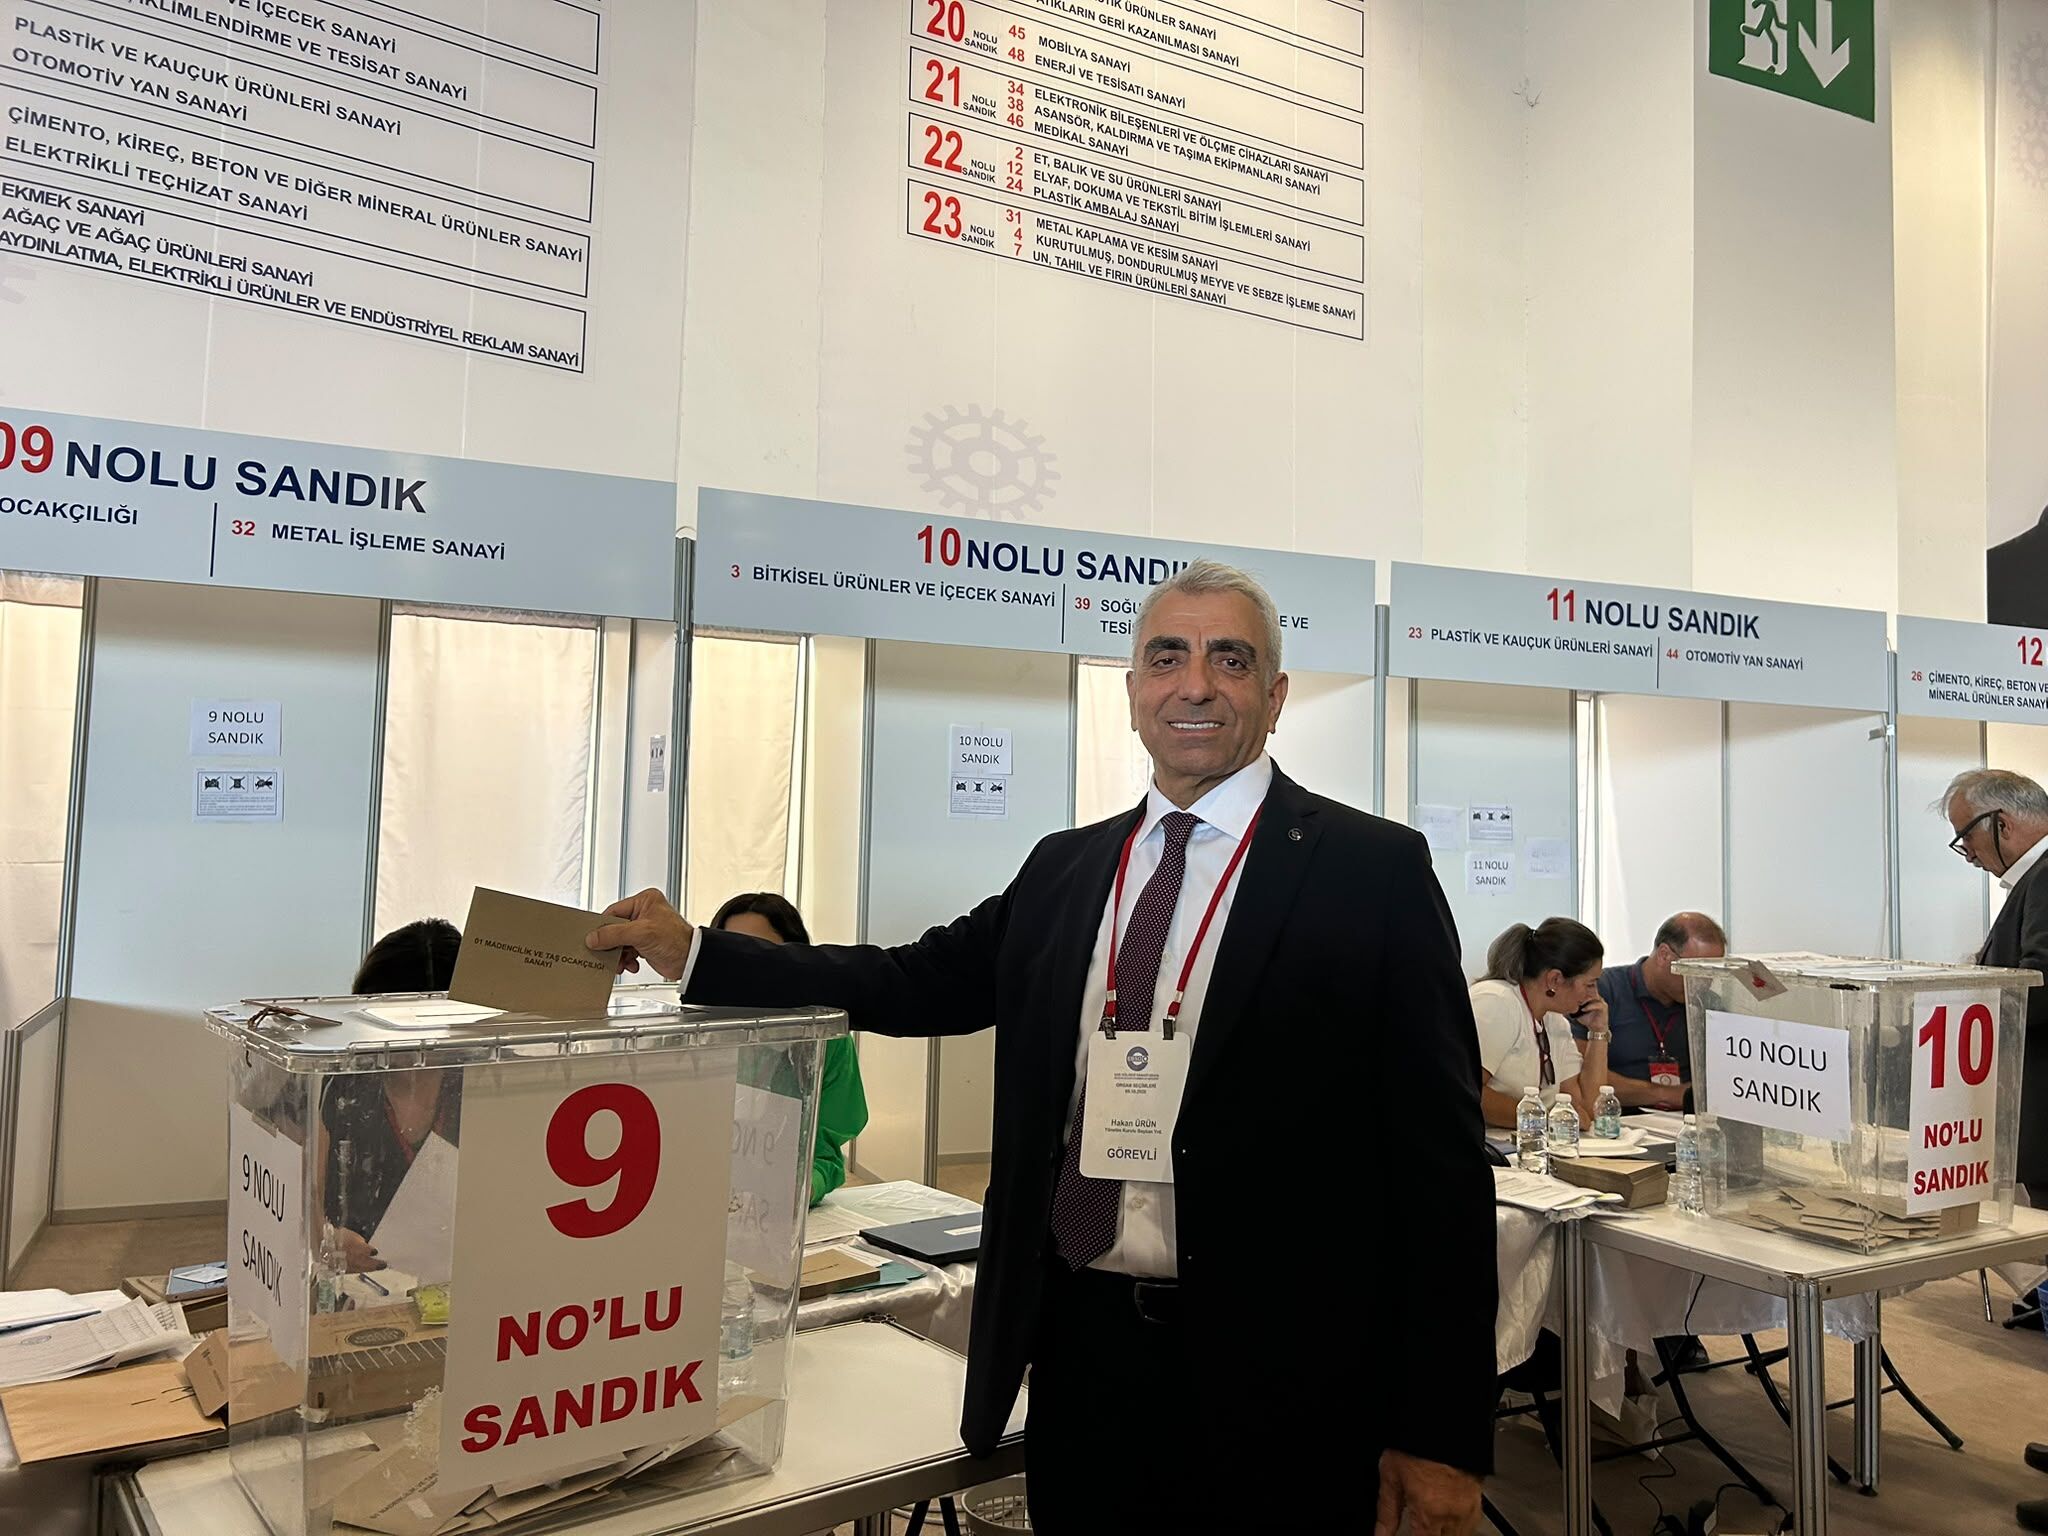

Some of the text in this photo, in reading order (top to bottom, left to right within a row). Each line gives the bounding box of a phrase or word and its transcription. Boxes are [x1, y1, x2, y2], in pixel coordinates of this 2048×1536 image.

[1008, 24, 1131, 73] 45 MOBİLYA SANAYİ
[12, 47, 247, 122] OTOMOTİV YAN SANAYİ
[15, 17, 401, 136] PLASTİK VE KAUÇUK ÜRÜNLERİ SANAYİ
[925, 59, 960, 107] 21
[1007, 46, 1186, 109] 48 ENERJİ VE TESİSATI SANAYİ
[962, 101, 997, 119] SANDIK
[971, 93, 997, 109] NOLU
[924, 124, 963, 174] 22
[1006, 112, 1129, 157] 46 MEDİKAL SANAYİ
[1007, 79, 1329, 183] 34 ELEKTRONİK BİLEŞENLERİ VE ÖLÇME CİHAZLARI SANAYİ
[1007, 95, 1321, 196] 38 ASANSÖR, KALDIRMA VE TAŞIMA EKİPMANLARI SANAYİ
[5, 135, 308, 221] ELEKTRİKLİ TEÇHİZAT SANAYİ
[8, 106, 583, 263] ÇİMENTO, KİREÇ, BETON VE DİĞER MİNERAL ÜRÜNLER SANAYİ
[962, 167, 996, 184] SANDIK
[970, 159, 996, 173] NOLU
[1, 181, 145, 227] EKMEK SANAYİ
[923, 191, 962, 239] 23
[1005, 175, 1179, 233] 24 PLASTİK AMBALAJ SANAYİ
[1, 206, 313, 287] AĞAÇ VE AĞAÇ ÜRÜNLERİ SANAYİ
[961, 232, 995, 249] SANDIK
[969, 224, 995, 238] NOLU
[1005, 208, 1219, 272] 31 METAL KAPLAMA VE KESİM SANAYİ
[1013, 227, 1356, 321] 4 KURUTULMUŞ, DONDURULMUŞ MEYVE VE SEBZE İŞLEME SANAYİ
[0, 230, 579, 367] AYDINLATMA, ELEKTRİKLİ ÜRÜNLER VE ENDÜSTRİYEL REKLAM SANAYİ
[65, 441, 217, 491] NOLU
[235, 460, 427, 514] SANDIK
[0, 497, 138, 525] OCAKÇILIĞI
[231, 519, 505, 561] 32 METAL İŞLEME SANAYİ
[917, 525, 1065, 577] 10 NOLU
[730, 563, 1055, 607] 3 BİTKİSEL ÜRÜNLER VE İÇECEK SANAYİ
[1546, 587, 1760, 640] 11 NOLU SANDIK
[1408, 626, 1653, 658] 23 PLASTİK VE KAUÇUK ÜRÜNLERİ SANAYİ
[1665, 647, 1803, 671] 44 OTOMOTİV YAN SANAYİ
[2017, 635, 2044, 667] 12
[1911, 670, 2037, 693] 26 ÇİMENTO, KİREÇ, BETON
[1928, 687, 2015, 707] MİNERAL ÜRÜNLER
[207, 731, 264, 745] SANDIK
[208, 710, 264, 724] 9 NOLU
[959, 735, 1003, 748] 10 NOLU
[961, 752, 1000, 765] SANDIK
[1473, 860, 1509, 871] 11 NOLU
[1475, 875, 1507, 886] SANDIK
[523, 956, 553, 969] SANAYİ
[1725, 1035, 1827, 1072] 10 NOLU
[1919, 1003, 1994, 1089] 10
[1732, 1076, 1822, 1113] SANDIK
[1110, 1118, 1157, 1129] Hakan ÜRÜN
[545, 1082, 661, 1239] 9
[1106, 1146, 1157, 1161] GÖREVLİ
[242, 1153, 286, 1222] 9 NOLU
[1913, 1160, 1990, 1196] SANDIK
[242, 1229, 283, 1307] SANDIK
[460, 1359, 704, 1454] SANDIK
